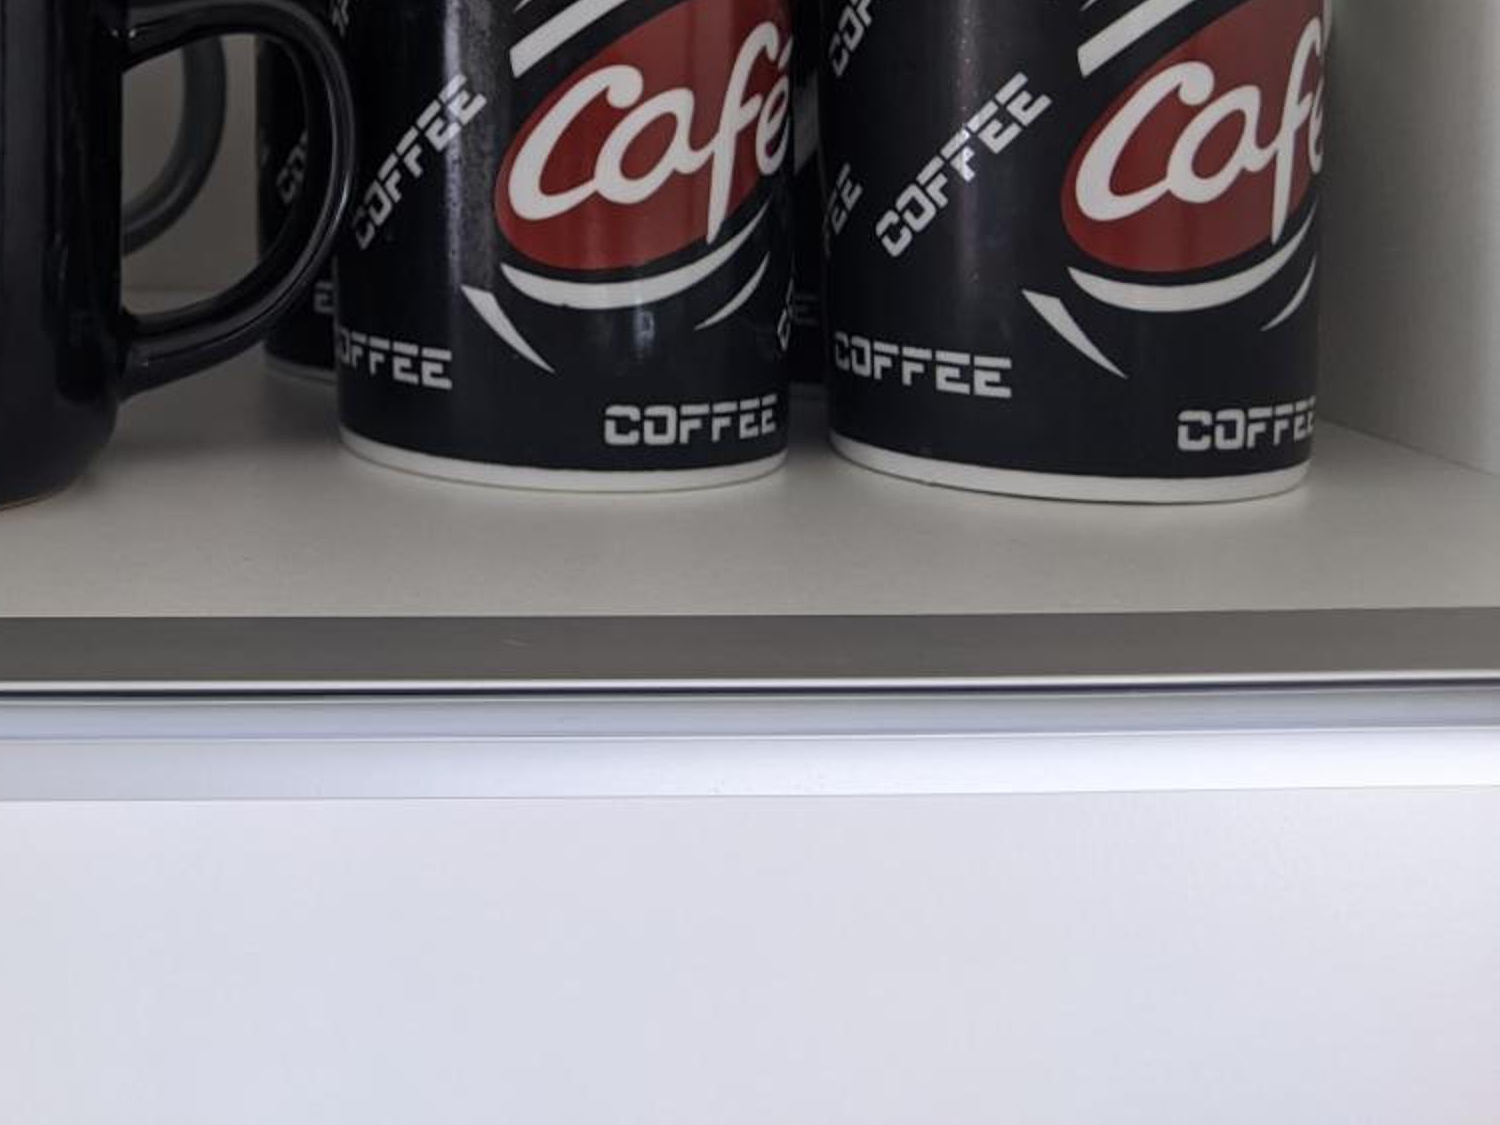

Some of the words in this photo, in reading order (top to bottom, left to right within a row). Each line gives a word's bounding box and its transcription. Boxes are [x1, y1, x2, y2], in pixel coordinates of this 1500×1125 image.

[353, 73, 488, 251] COFFEE
[875, 71, 1052, 258] COFFEE
[339, 326, 453, 390] OFFEE
[835, 331, 1012, 399] COFFEE
[604, 393, 778, 446] COFFEE
